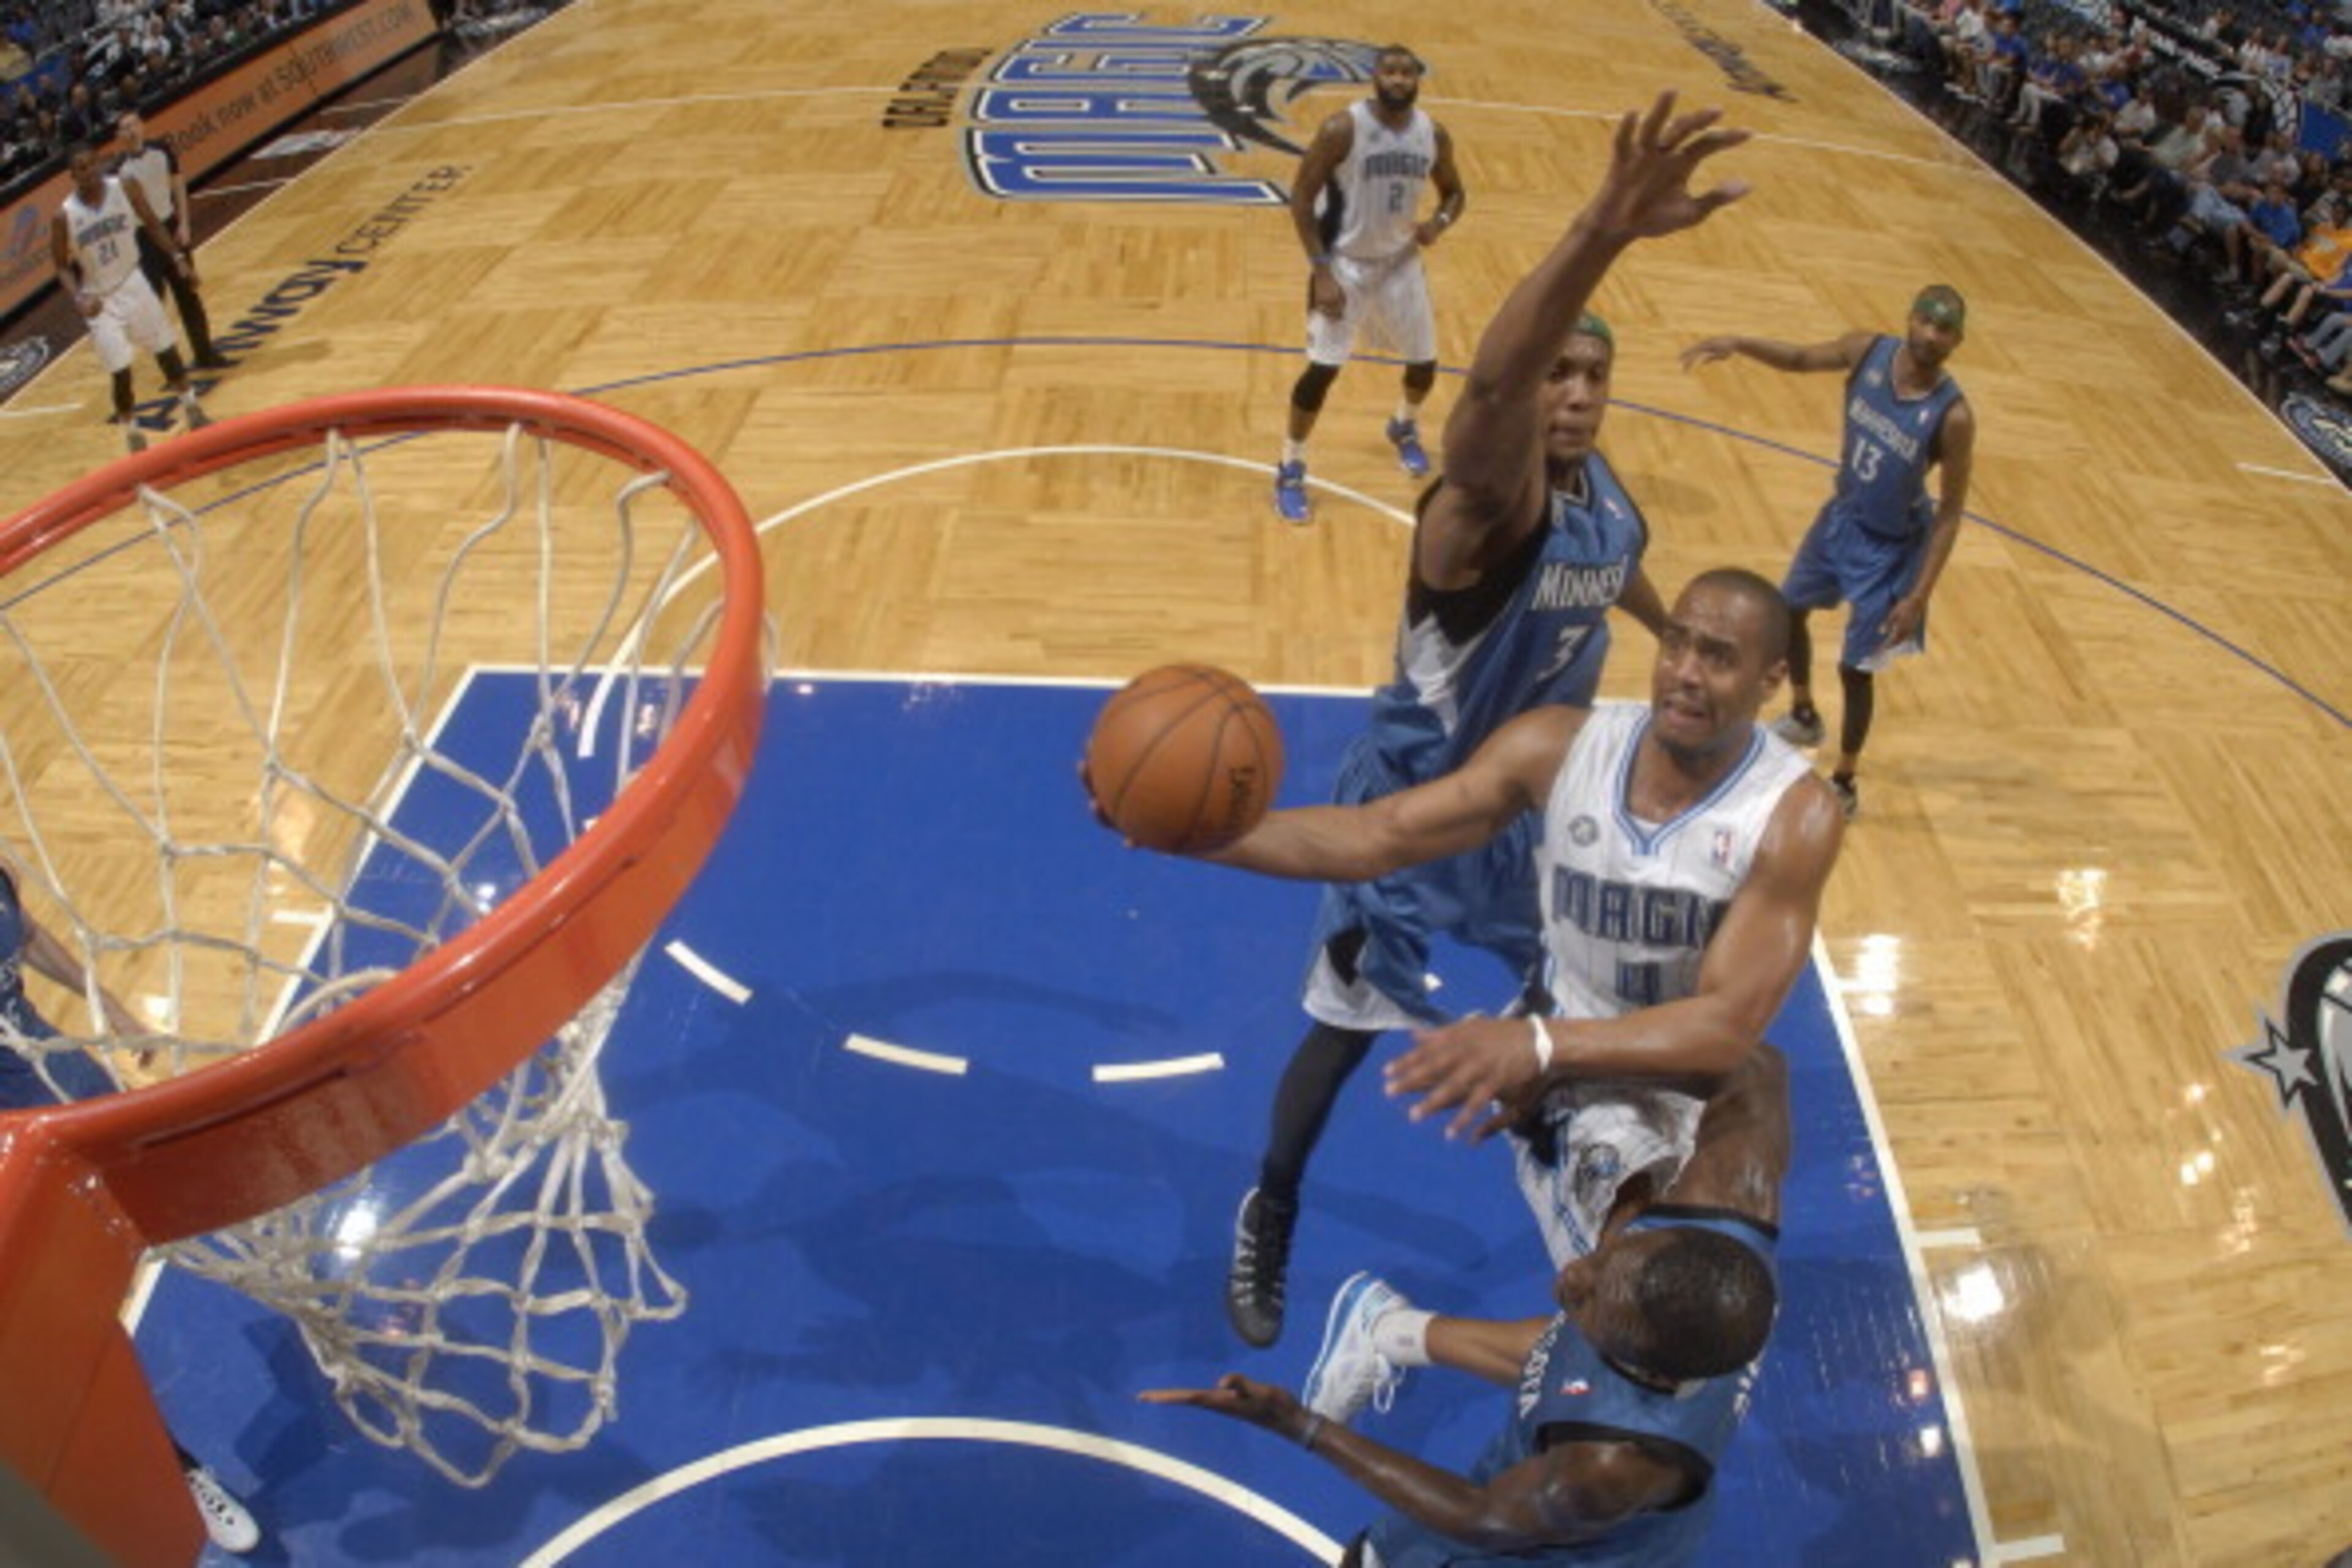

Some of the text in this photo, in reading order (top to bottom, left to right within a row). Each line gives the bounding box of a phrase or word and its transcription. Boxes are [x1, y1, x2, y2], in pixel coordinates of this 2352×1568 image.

[217, 93, 255, 126] now
[258, 75, 279, 105] at
[1389, 183, 1405, 213] 2
[1852, 435, 1883, 481] 13
[1535, 624, 1593, 682] 3
